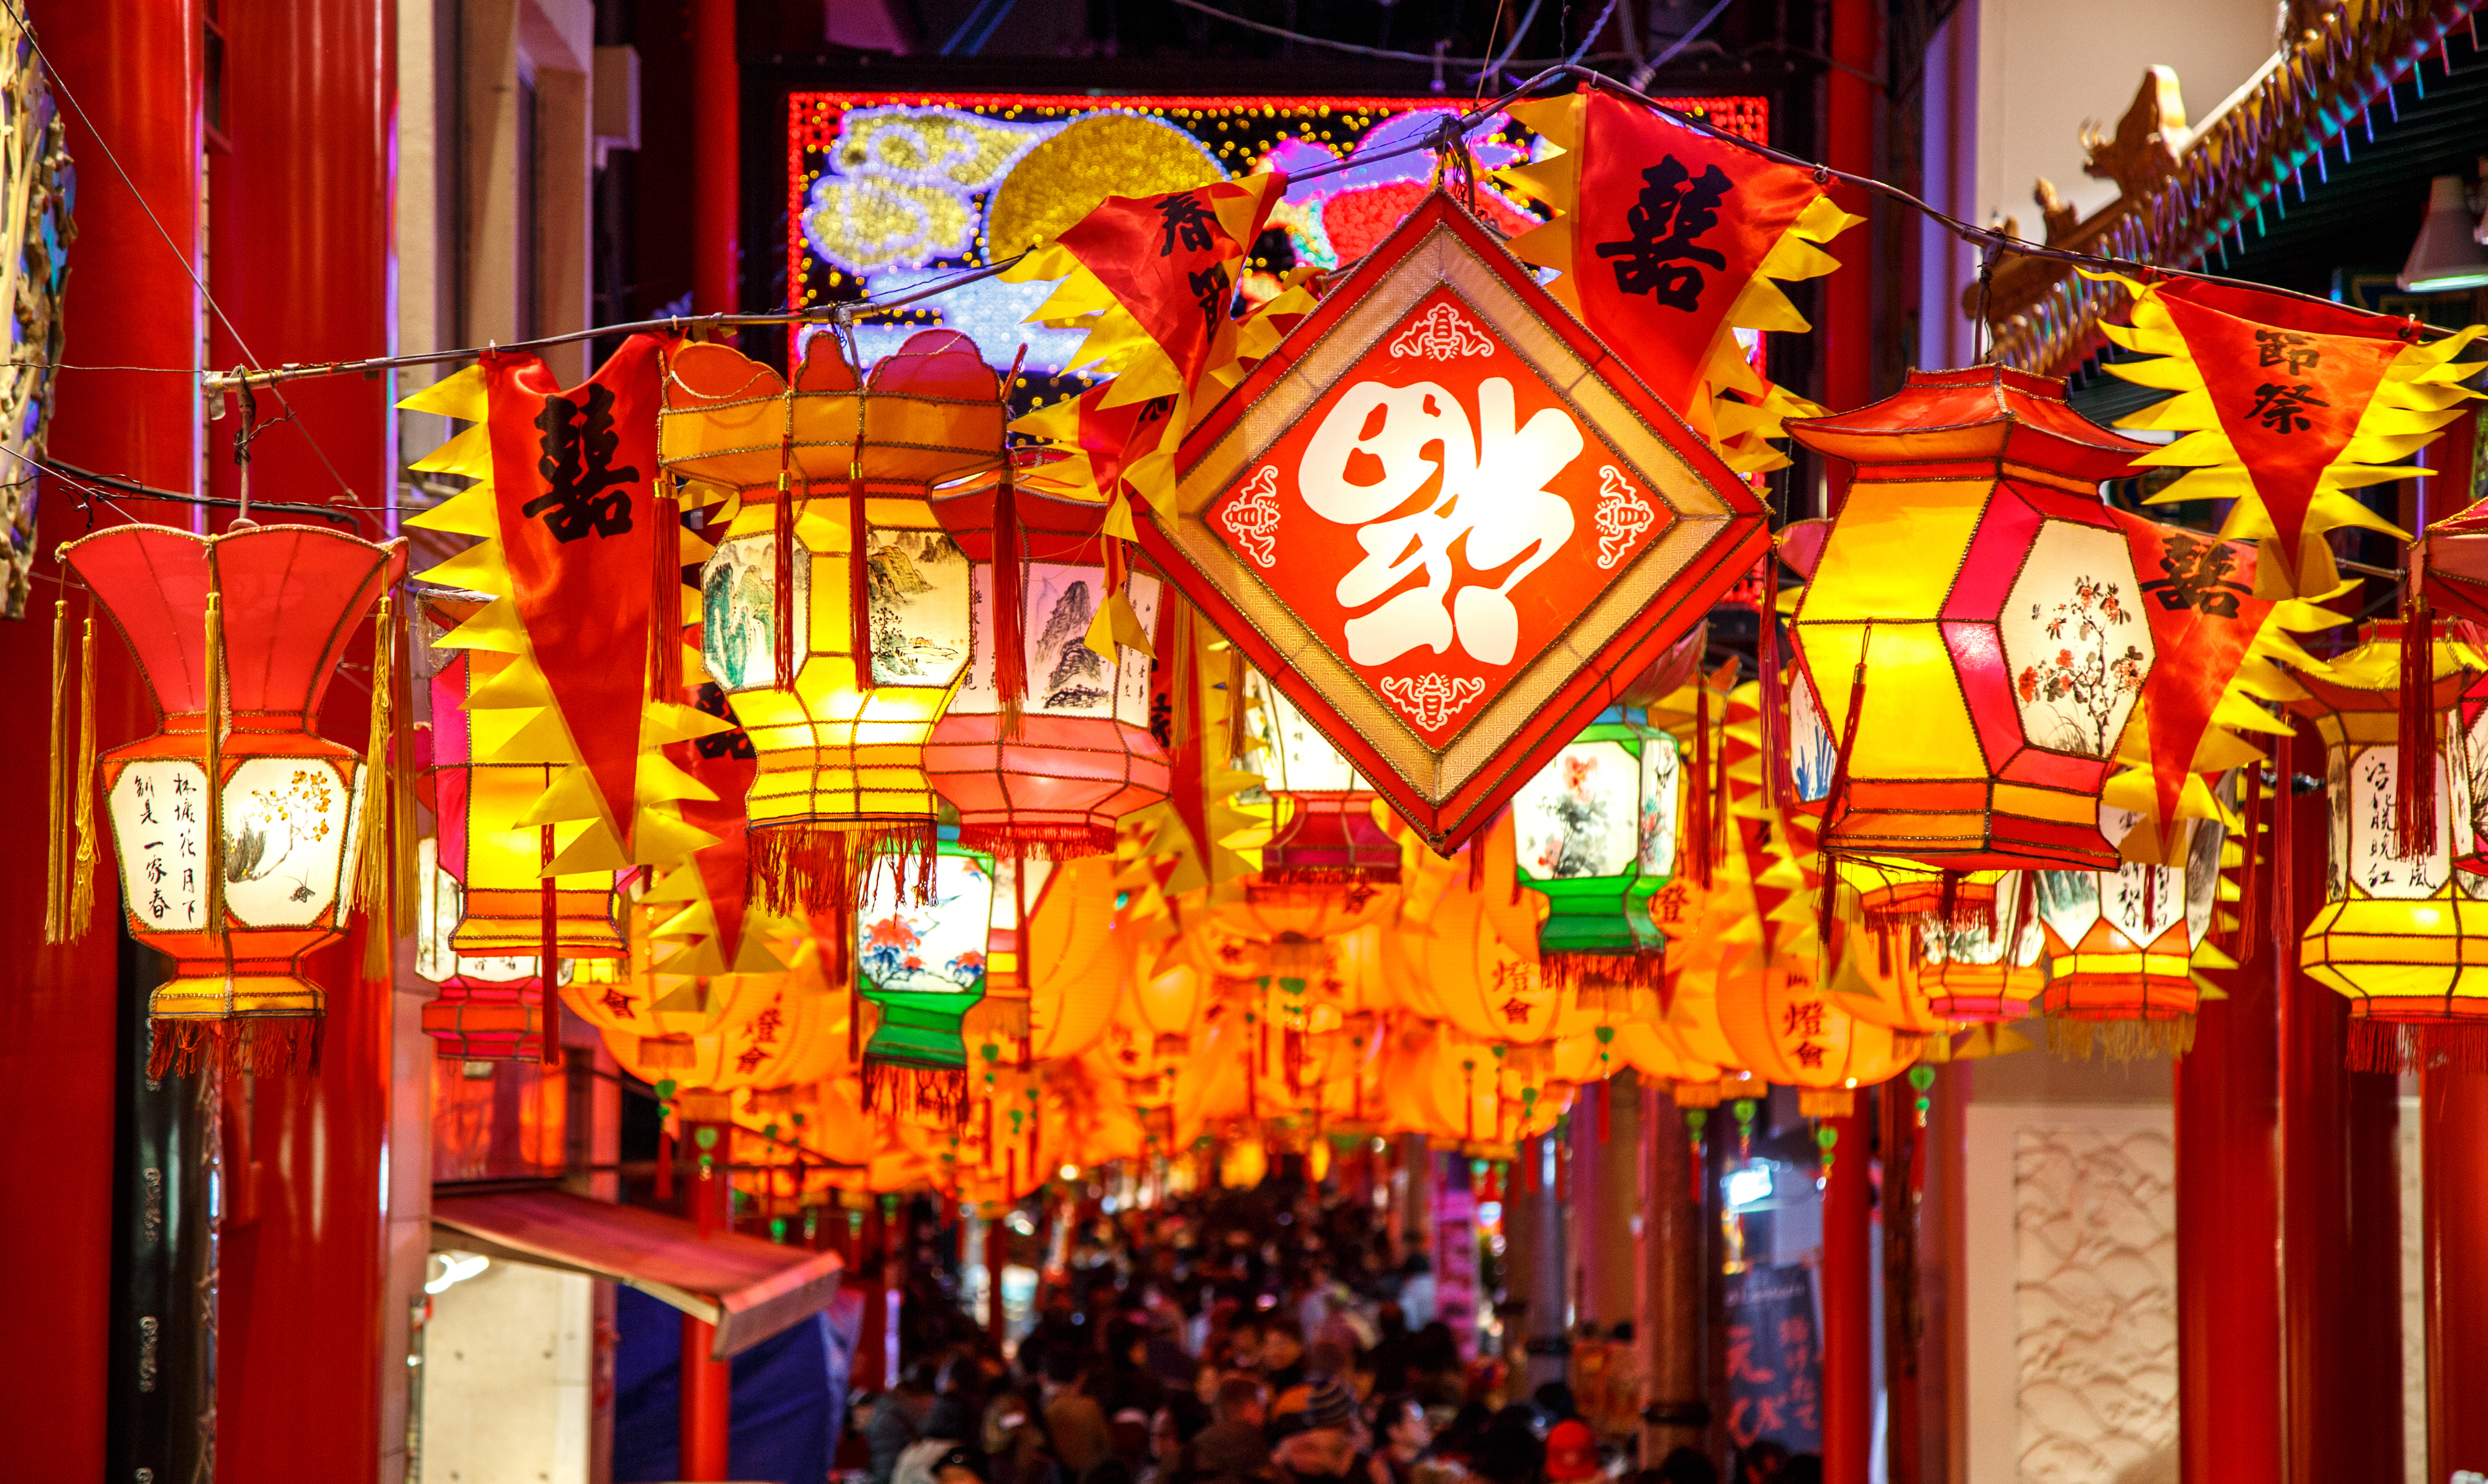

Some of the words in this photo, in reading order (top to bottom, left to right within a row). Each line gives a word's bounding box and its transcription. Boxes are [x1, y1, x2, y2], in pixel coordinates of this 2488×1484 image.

[2244, 329, 2330, 435] 節祭
[1298, 377, 1584, 665] 福
[1784, 972, 1827, 1069] 燈會
